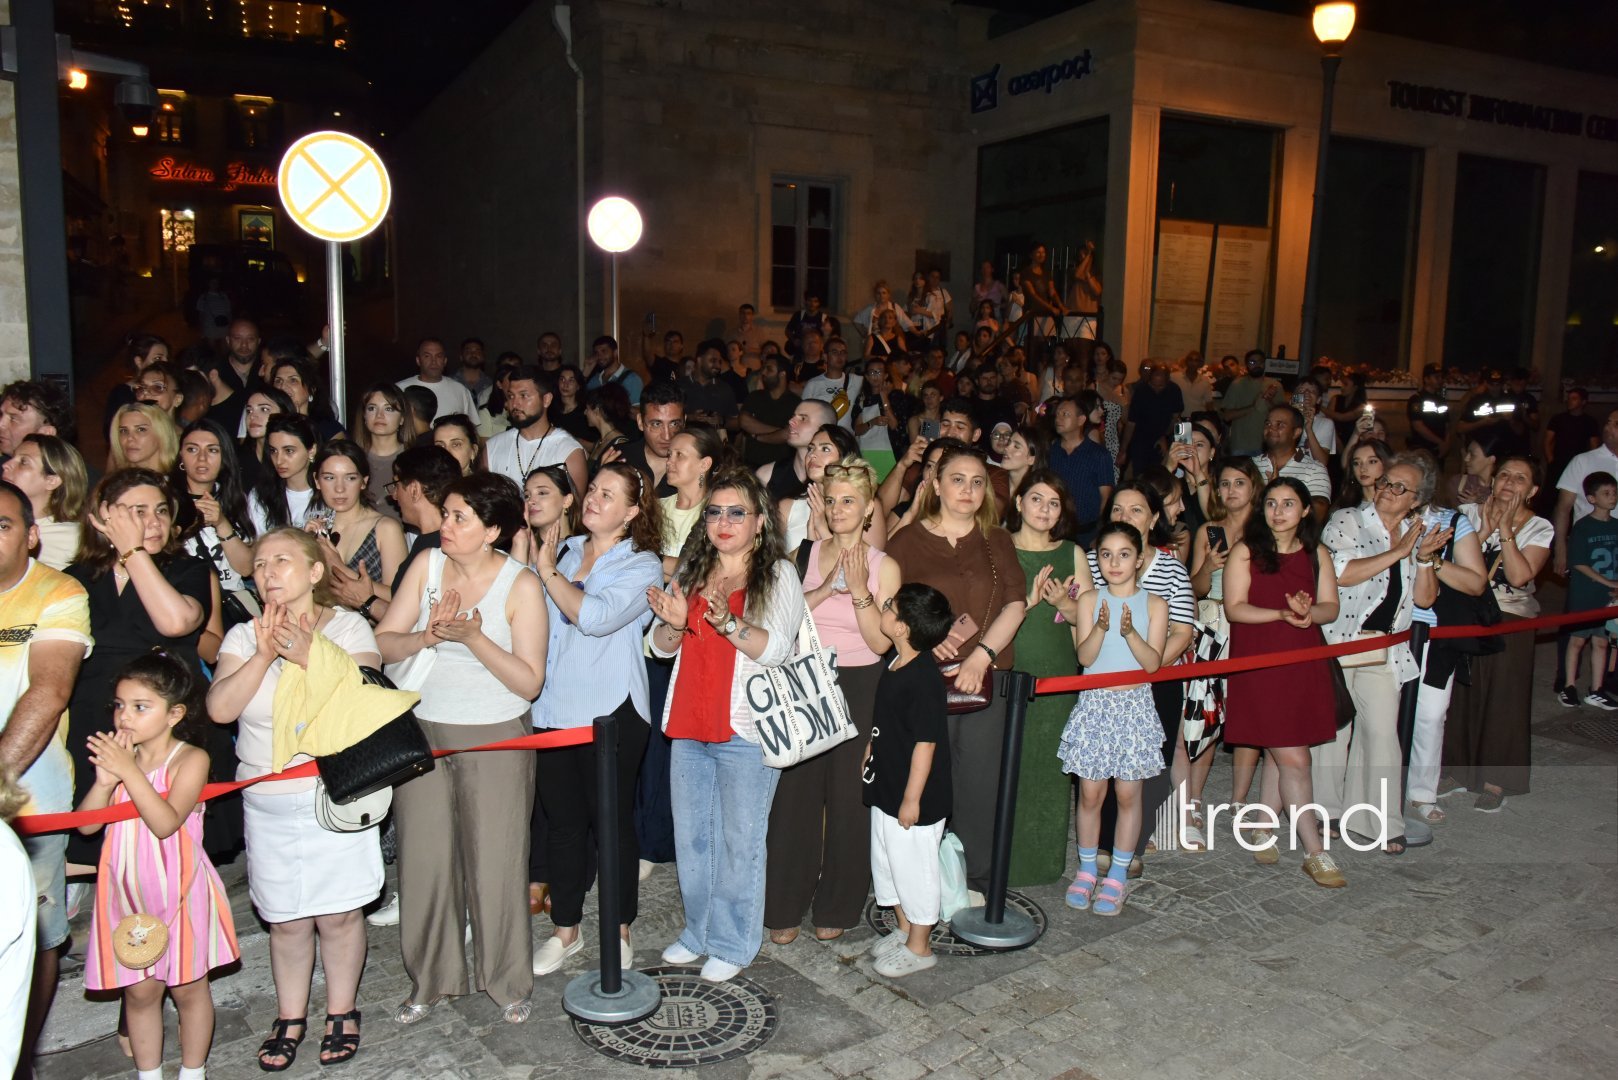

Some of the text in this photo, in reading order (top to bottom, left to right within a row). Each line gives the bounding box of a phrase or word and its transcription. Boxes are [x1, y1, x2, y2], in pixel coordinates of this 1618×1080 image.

[1388, 80, 1466, 117] TOURIST
[150, 158, 213, 180] Salam
[811, 636, 828, 677] GENTLEWOMAN
[826, 679, 844, 720] GENTLEWOMAN
